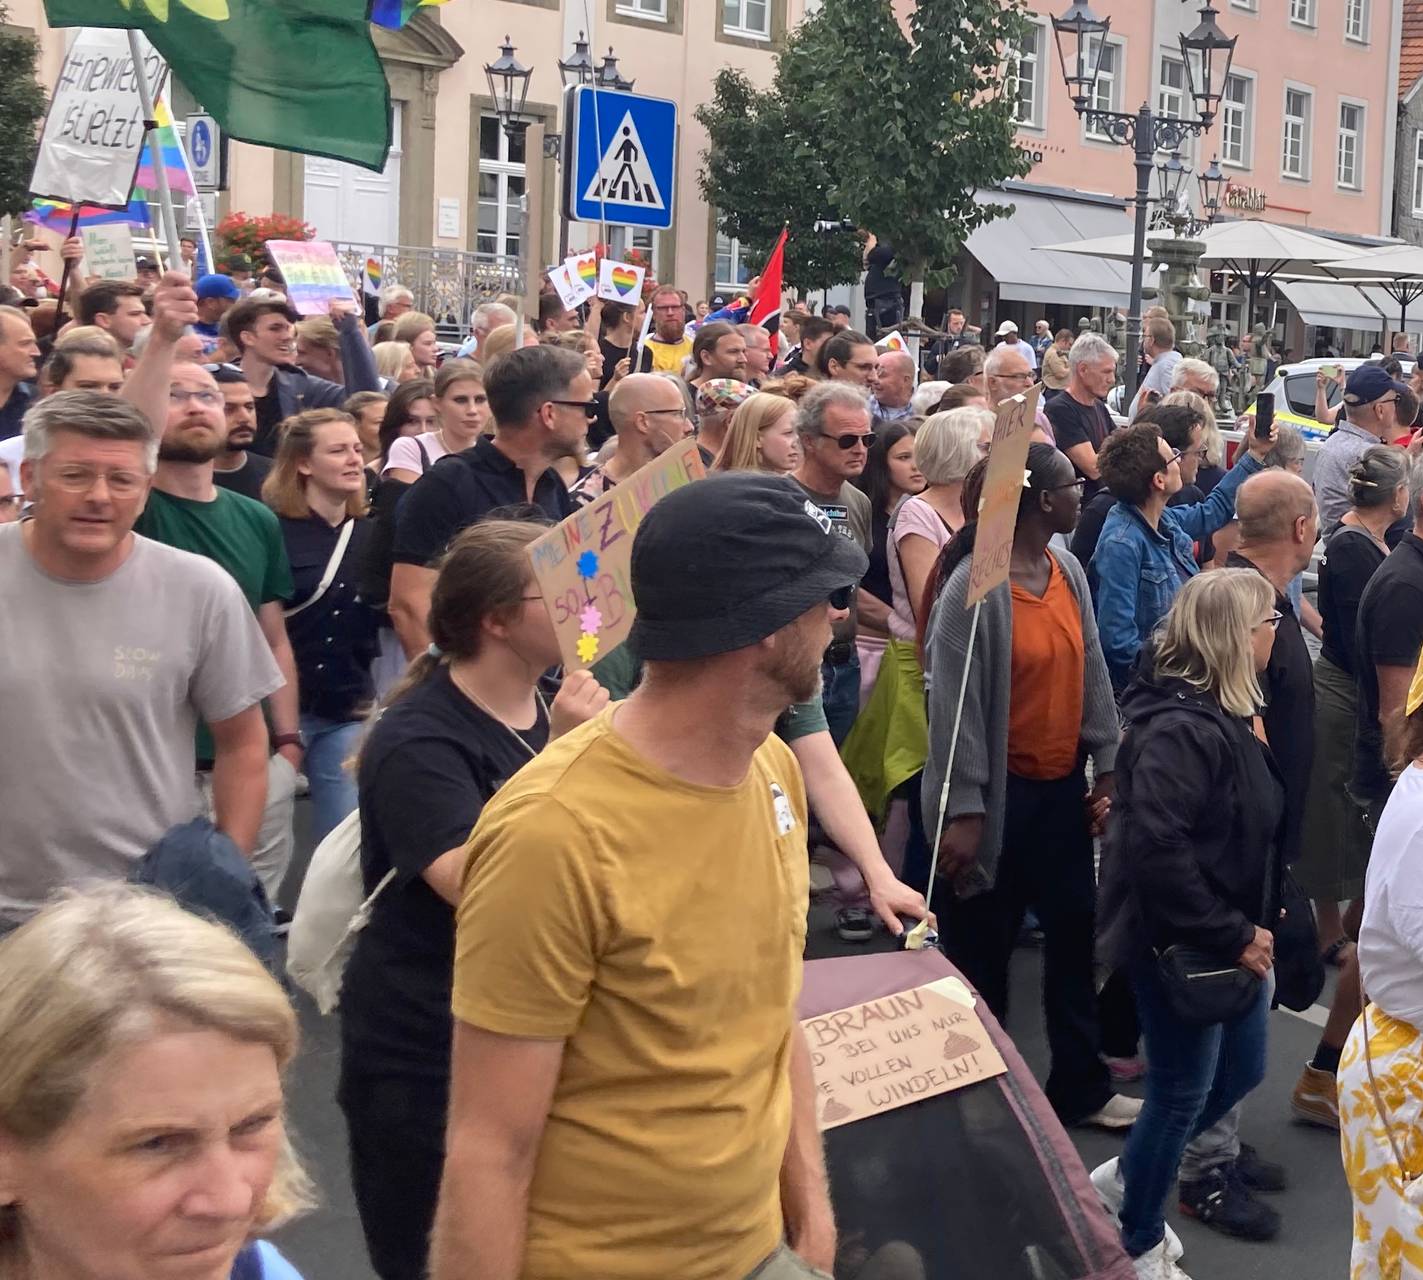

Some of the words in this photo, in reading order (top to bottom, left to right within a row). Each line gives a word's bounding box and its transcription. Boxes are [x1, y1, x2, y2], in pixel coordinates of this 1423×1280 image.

[61, 100, 86, 140] ist
[82, 103, 140, 149] jetzt
[996, 401, 1027, 441] HIER
[805, 990, 925, 1047] BRAUN
[812, 1053, 826, 1067] D
[838, 1039, 878, 1058] BEI
[888, 1024, 921, 1044] UNS
[931, 1012, 968, 1032] NUR
[841, 1055, 912, 1087] VOLLEN
[867, 1053, 984, 1107] WINDELN!
